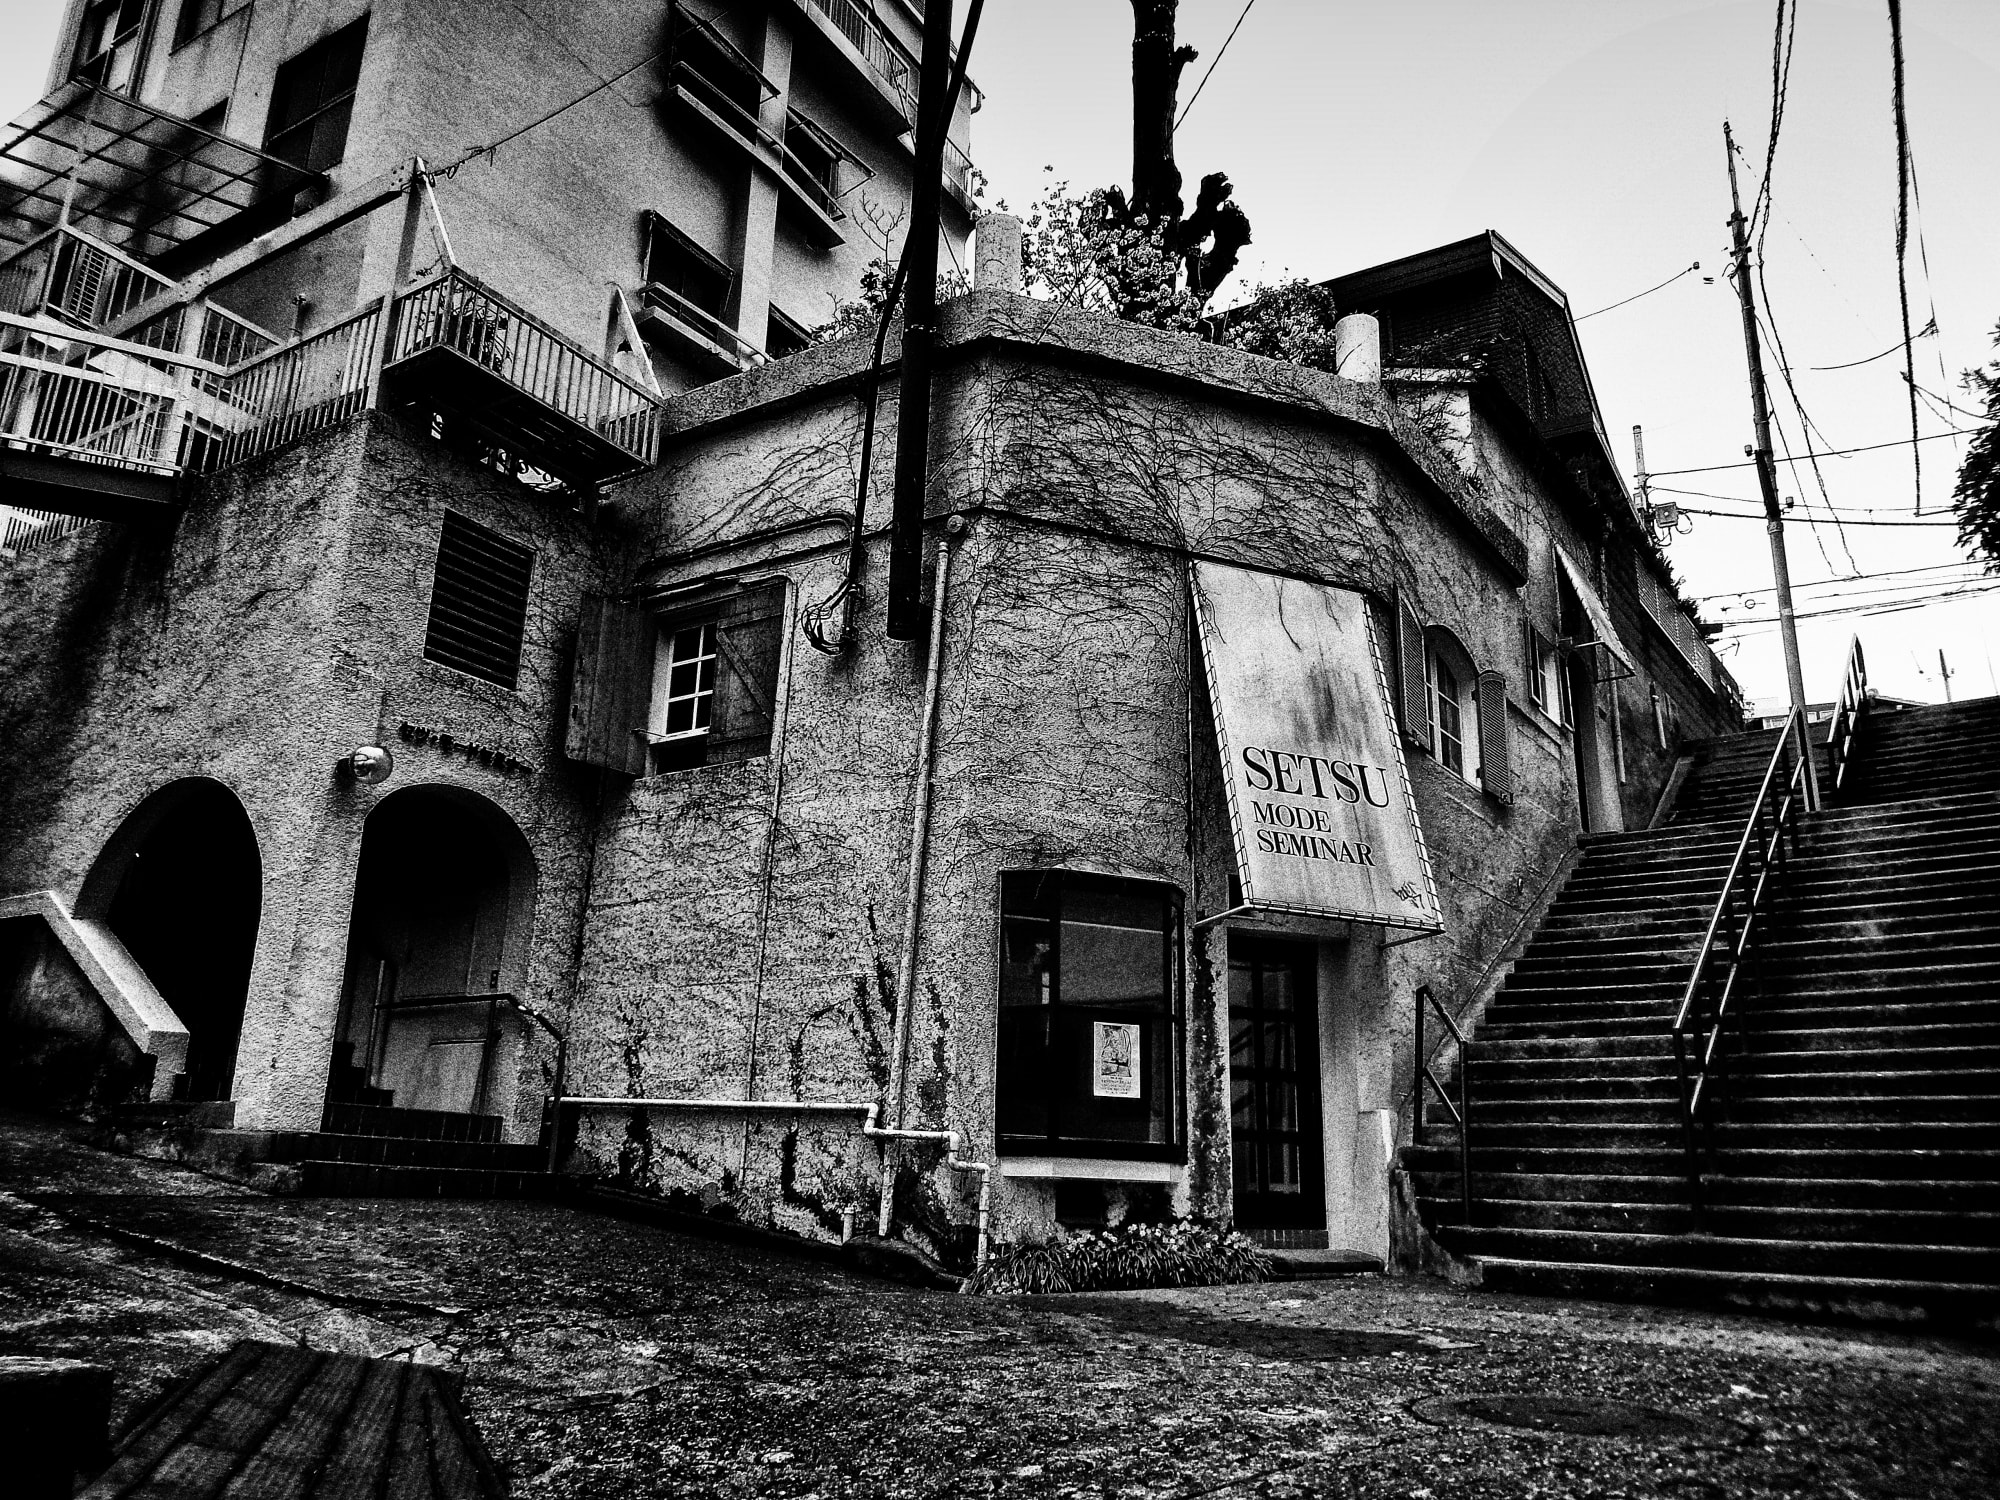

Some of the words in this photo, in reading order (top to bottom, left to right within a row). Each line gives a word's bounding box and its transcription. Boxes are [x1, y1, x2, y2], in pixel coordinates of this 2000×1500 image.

[1242, 746, 1390, 808] SETSU
[1251, 800, 1332, 833] MODE
[1256, 829, 1376, 867] SEMINAR
